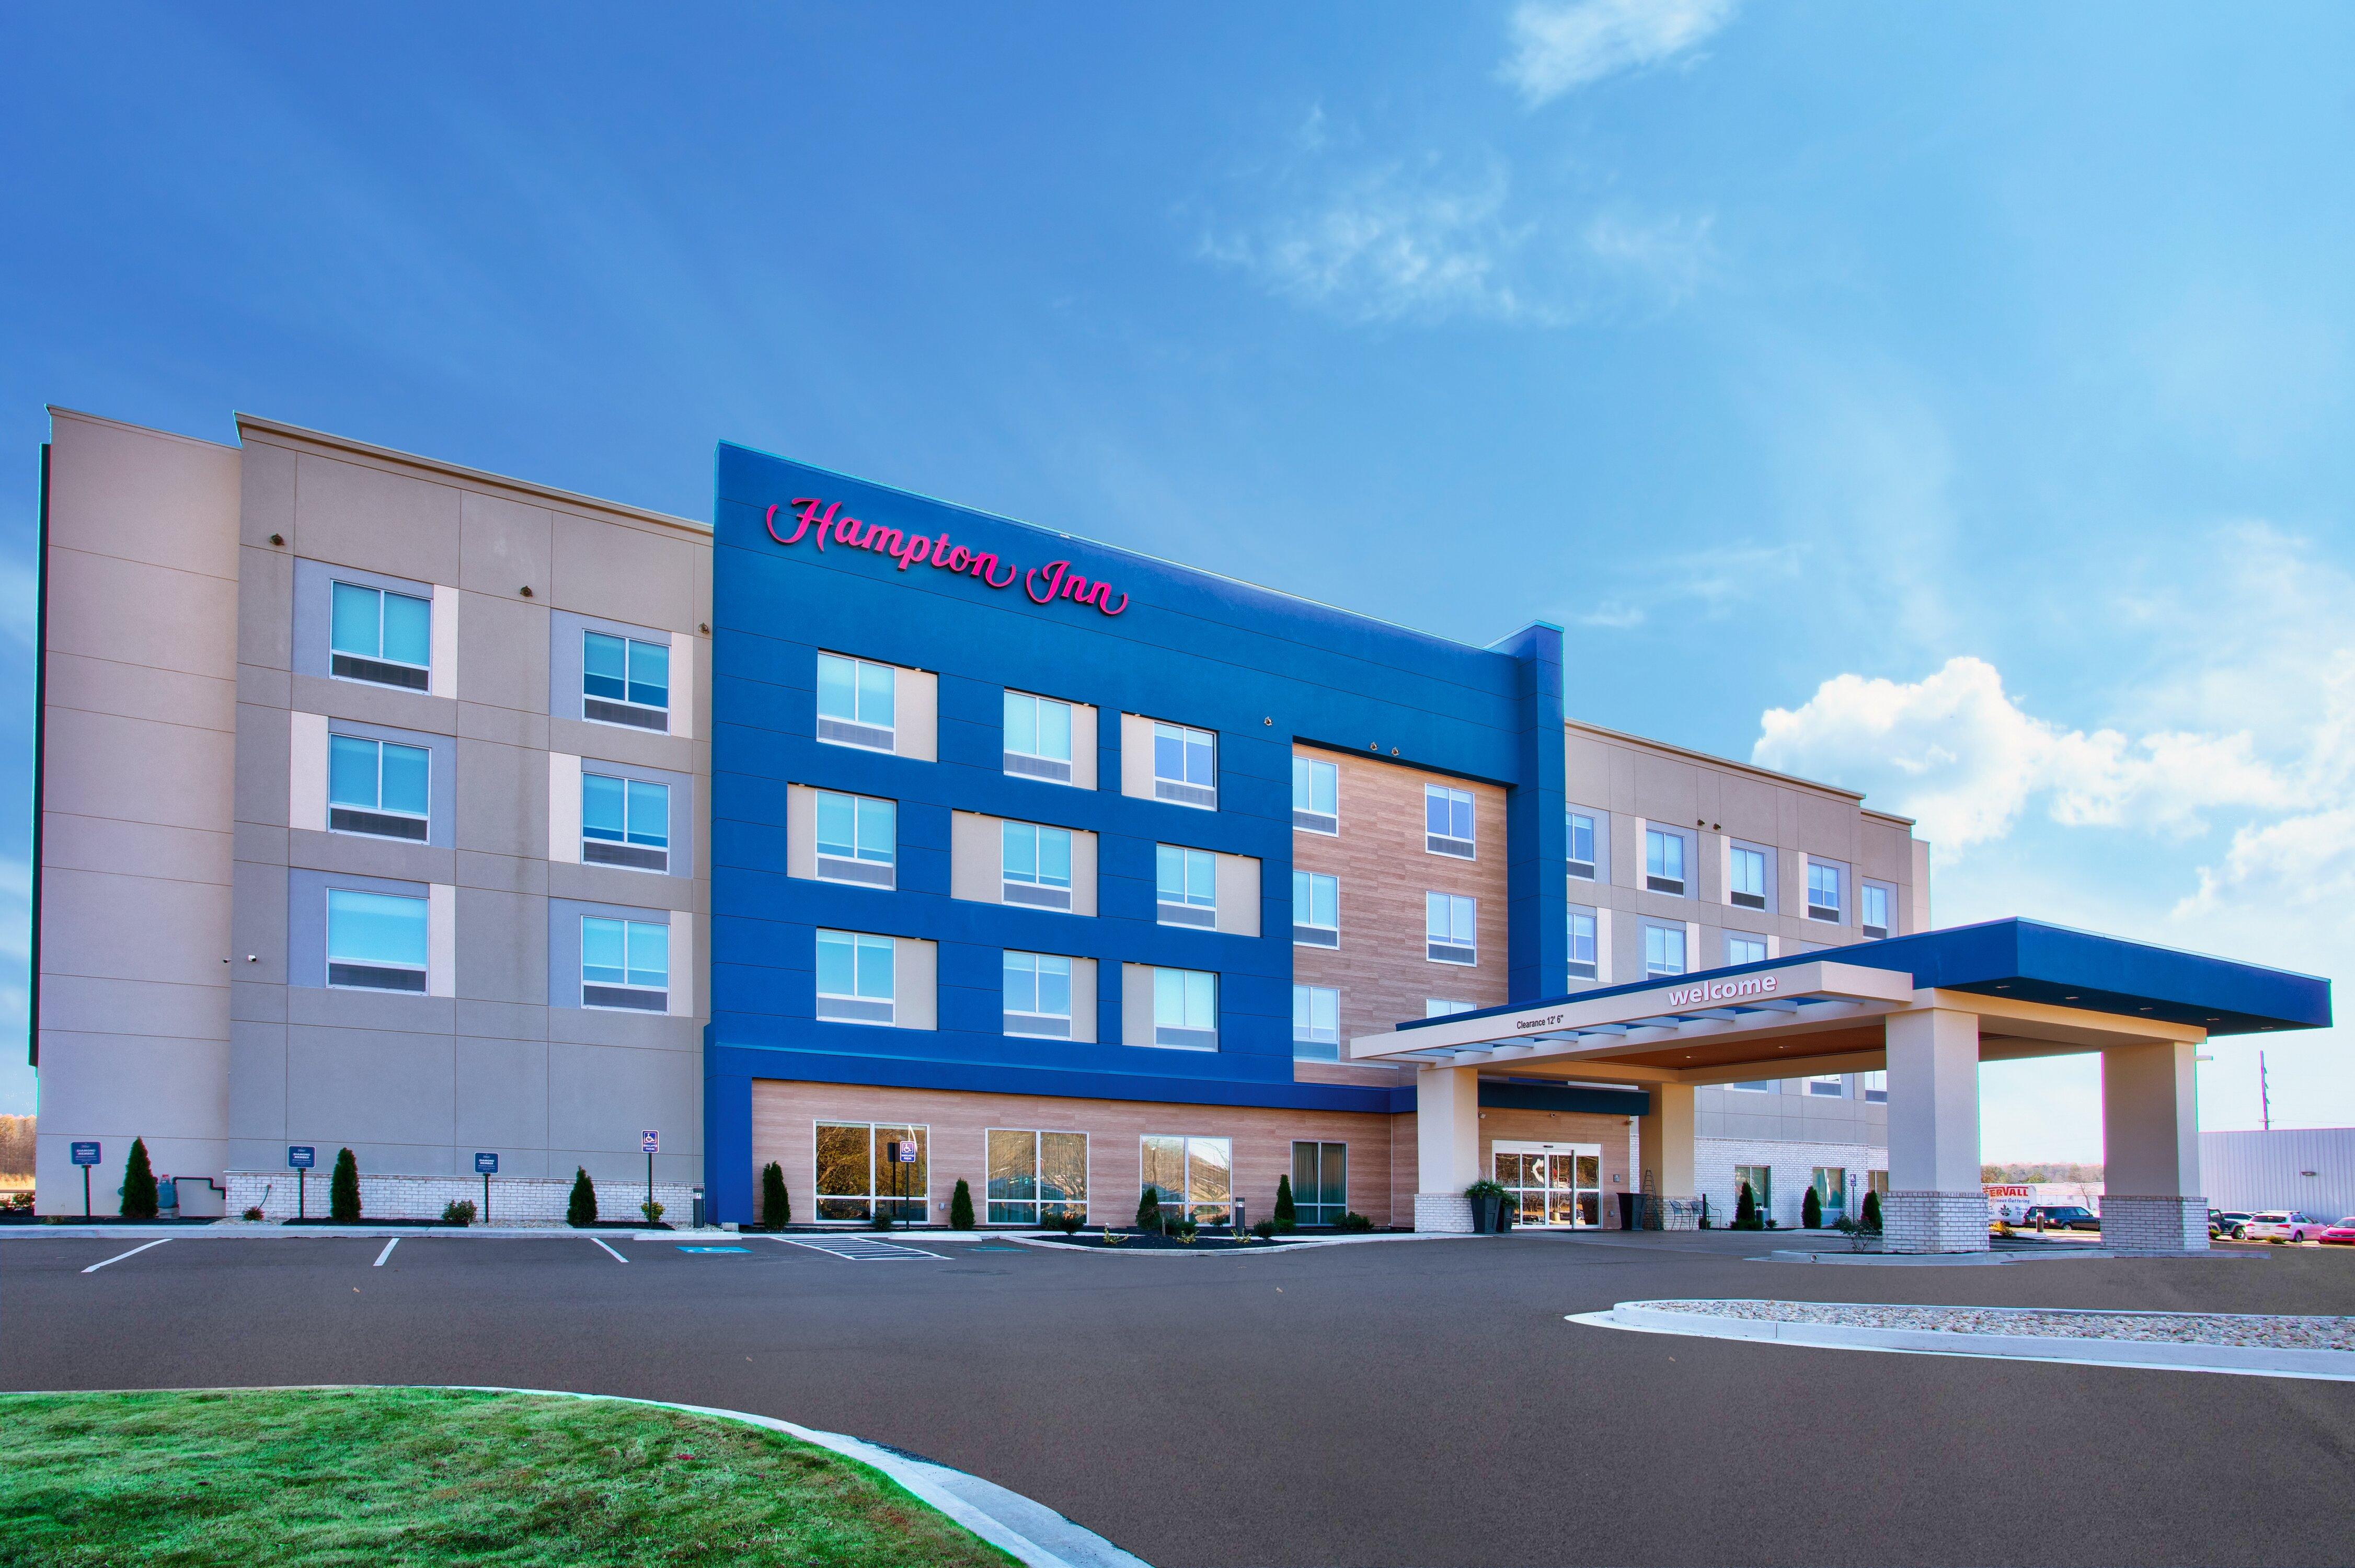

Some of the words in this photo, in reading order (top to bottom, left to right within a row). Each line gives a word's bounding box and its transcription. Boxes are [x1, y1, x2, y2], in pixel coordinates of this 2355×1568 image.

[766, 498, 1016, 587] Hampton
[1026, 560, 1128, 616] Inn
[1669, 976, 1777, 1006] welcome
[1517, 1019, 1545, 1029] Clearance
